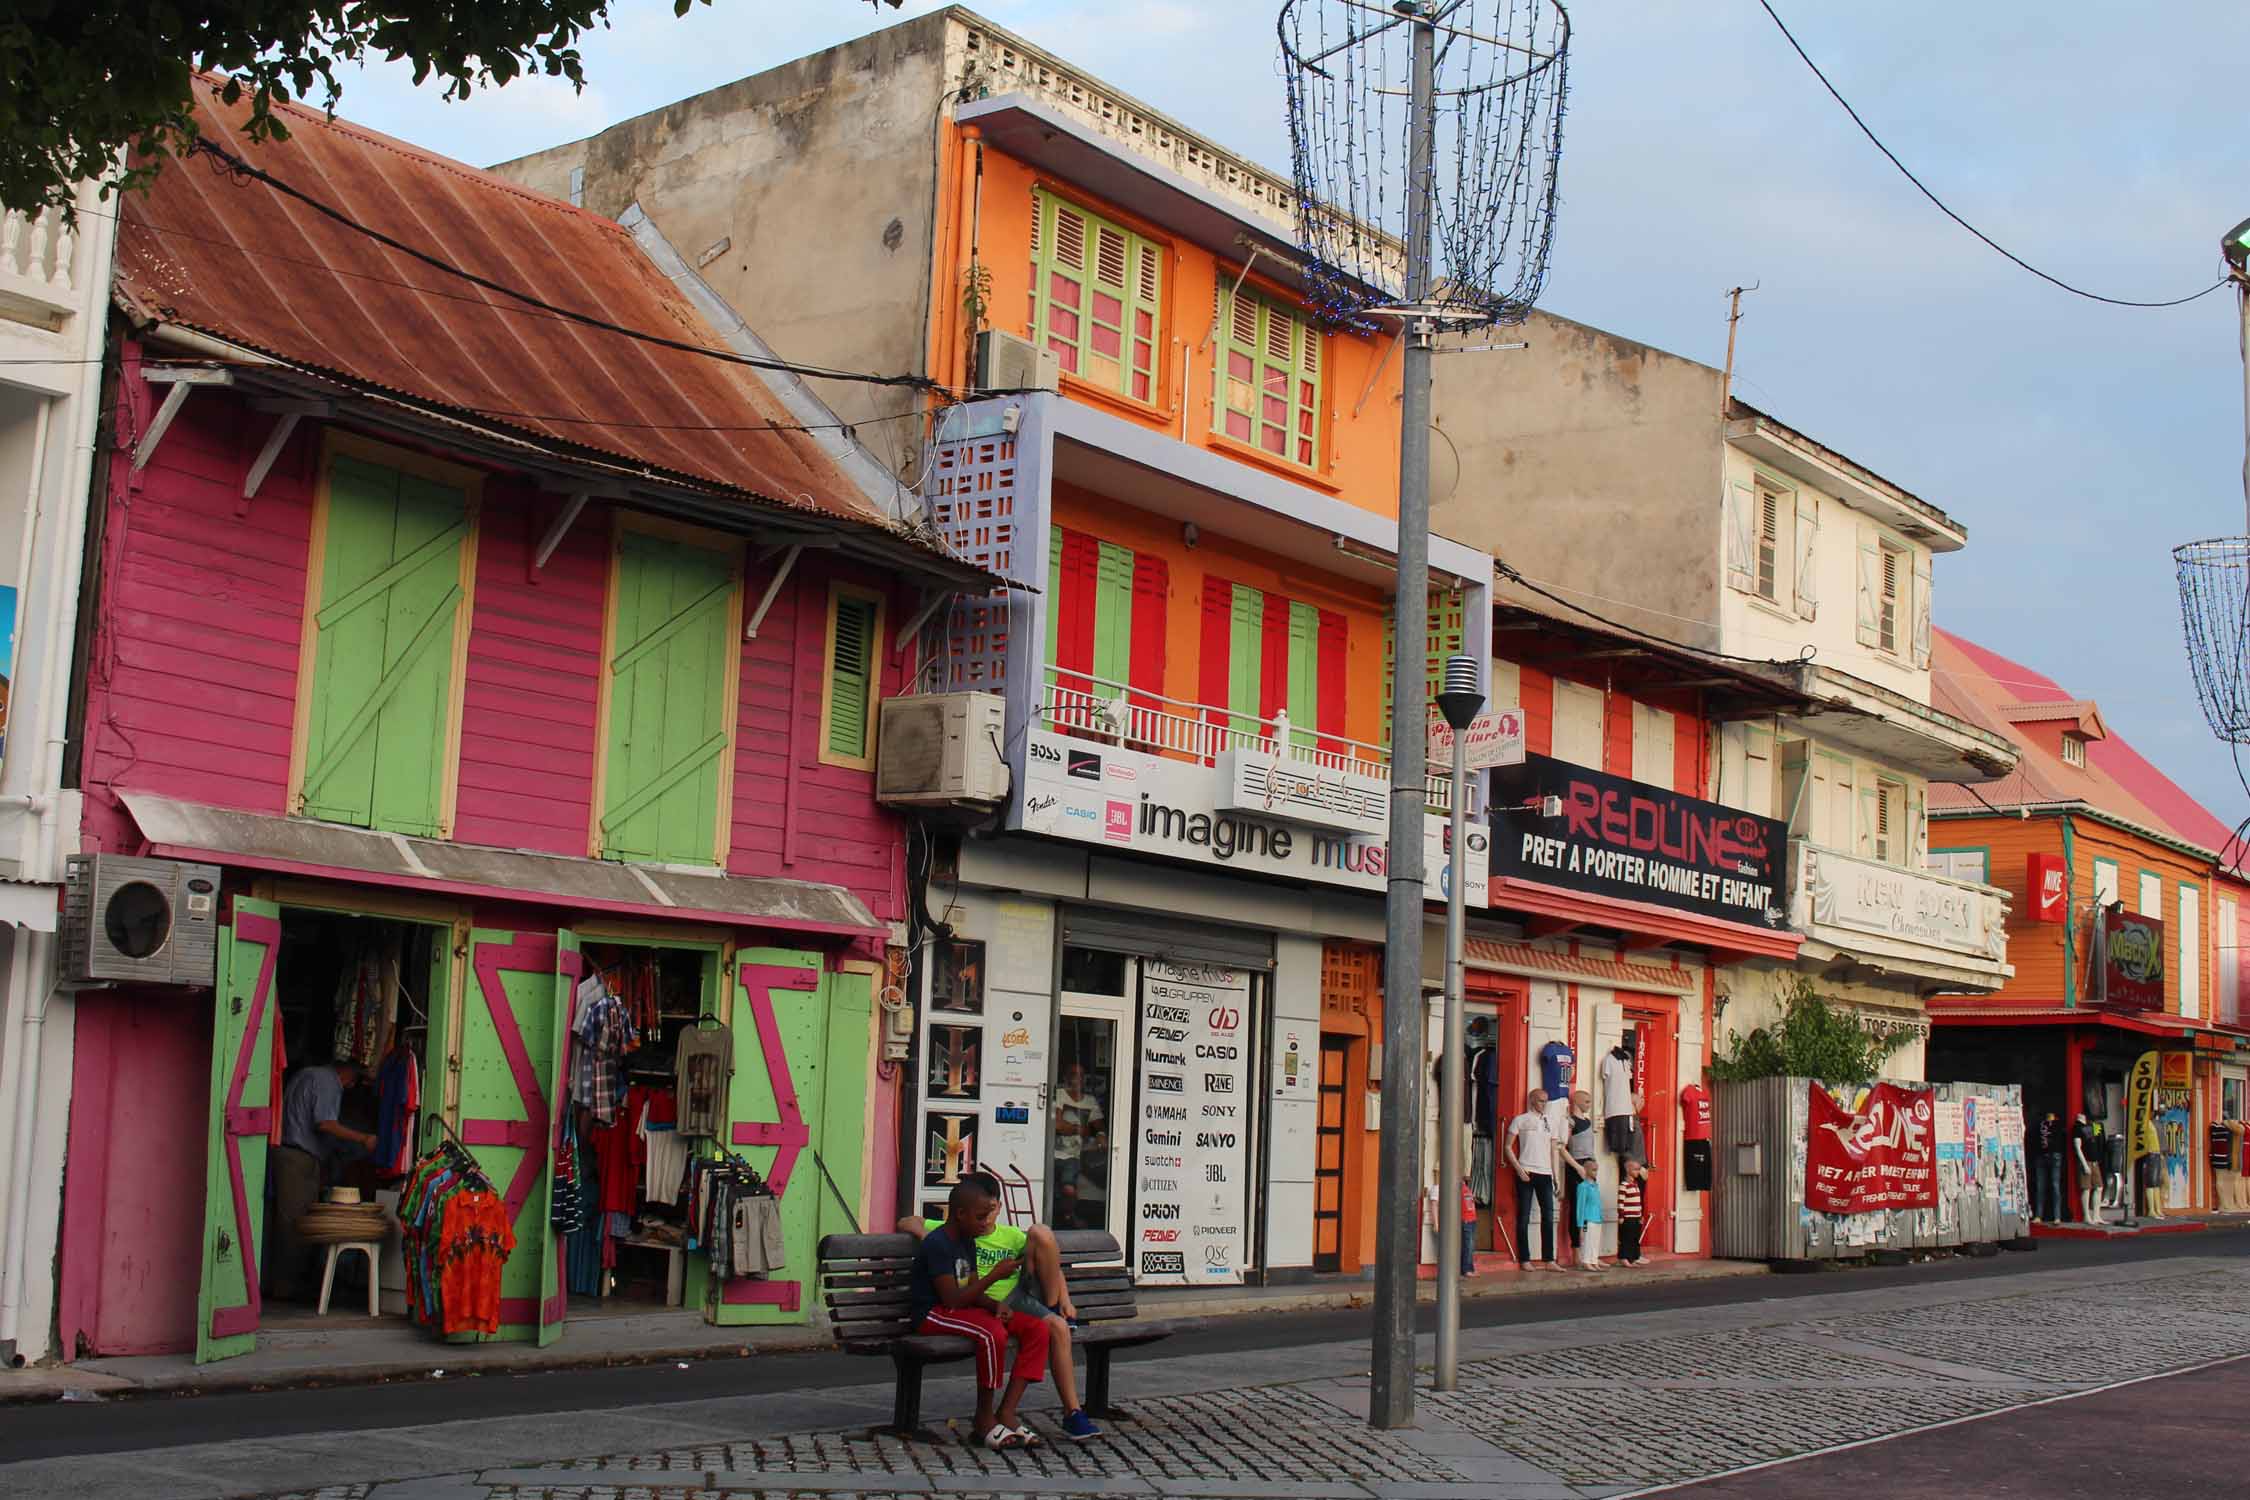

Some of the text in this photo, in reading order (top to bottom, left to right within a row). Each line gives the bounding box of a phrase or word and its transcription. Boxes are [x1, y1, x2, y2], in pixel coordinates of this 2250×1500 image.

[1030, 744, 1061, 761] BOSS
[1027, 794, 1057, 814] Fender
[1065, 807, 1097, 820] CASIO
[1111, 810, 1127, 826] JBL
[1139, 793, 1292, 860] imagine
[1521, 833, 1772, 910] PRET A PORTER HOMME ET ENFANT
[1465, 881, 1486, 890] SONY
[2043, 869, 2062, 892] NIKE
[1146, 1004, 1190, 1023] KICKER
[1865, 1018, 1927, 1036] TOP SHOES
[1145, 1048, 1186, 1066] Numark
[1195, 1045, 1237, 1060] CASIO
[1205, 1073, 1232, 1092] RANE
[1154, 1105, 1187, 1120] YAMAHA
[1202, 1105, 1236, 1117] SONY
[1146, 1129, 1181, 1146] Gemini
[1196, 1133, 1236, 1148] SANYO
[1145, 1156, 1174, 1167] swatch
[1206, 1164, 1226, 1182] JBL
[1149, 1178, 1177, 1191] CITIZEN
[1201, 1226, 1237, 1234] PIONEER
[1154, 1255, 1181, 1263] CREST
[1204, 1245, 1229, 1266] QSC
[1154, 1263, 1181, 1271] AUDIO
